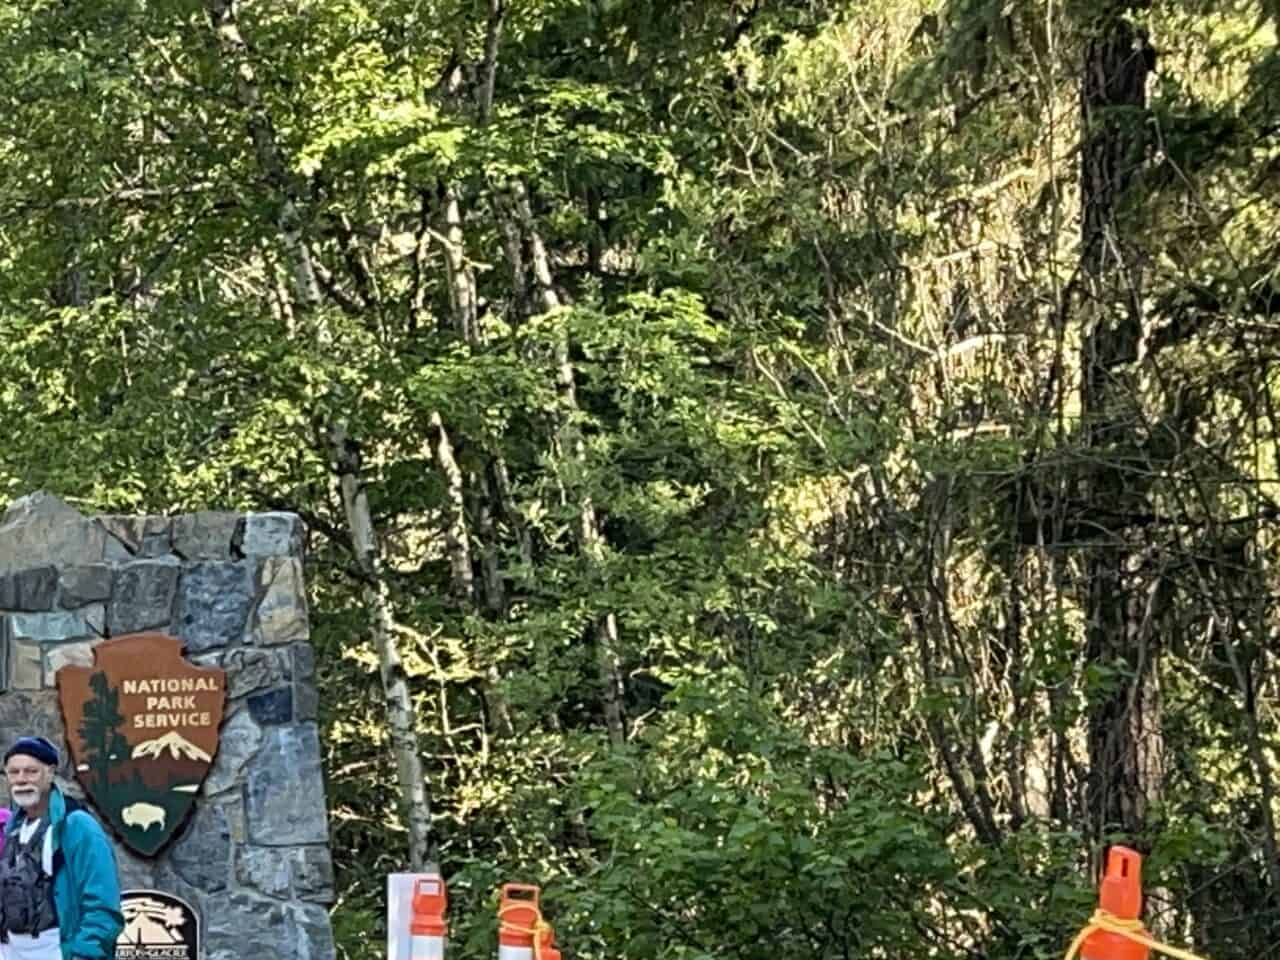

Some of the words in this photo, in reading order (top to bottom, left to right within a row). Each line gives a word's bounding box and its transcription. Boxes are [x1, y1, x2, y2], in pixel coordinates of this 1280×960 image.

[123, 677, 219, 694] NATIONAL
[146, 695, 197, 711] PARK
[133, 712, 211, 729] SERVICE
